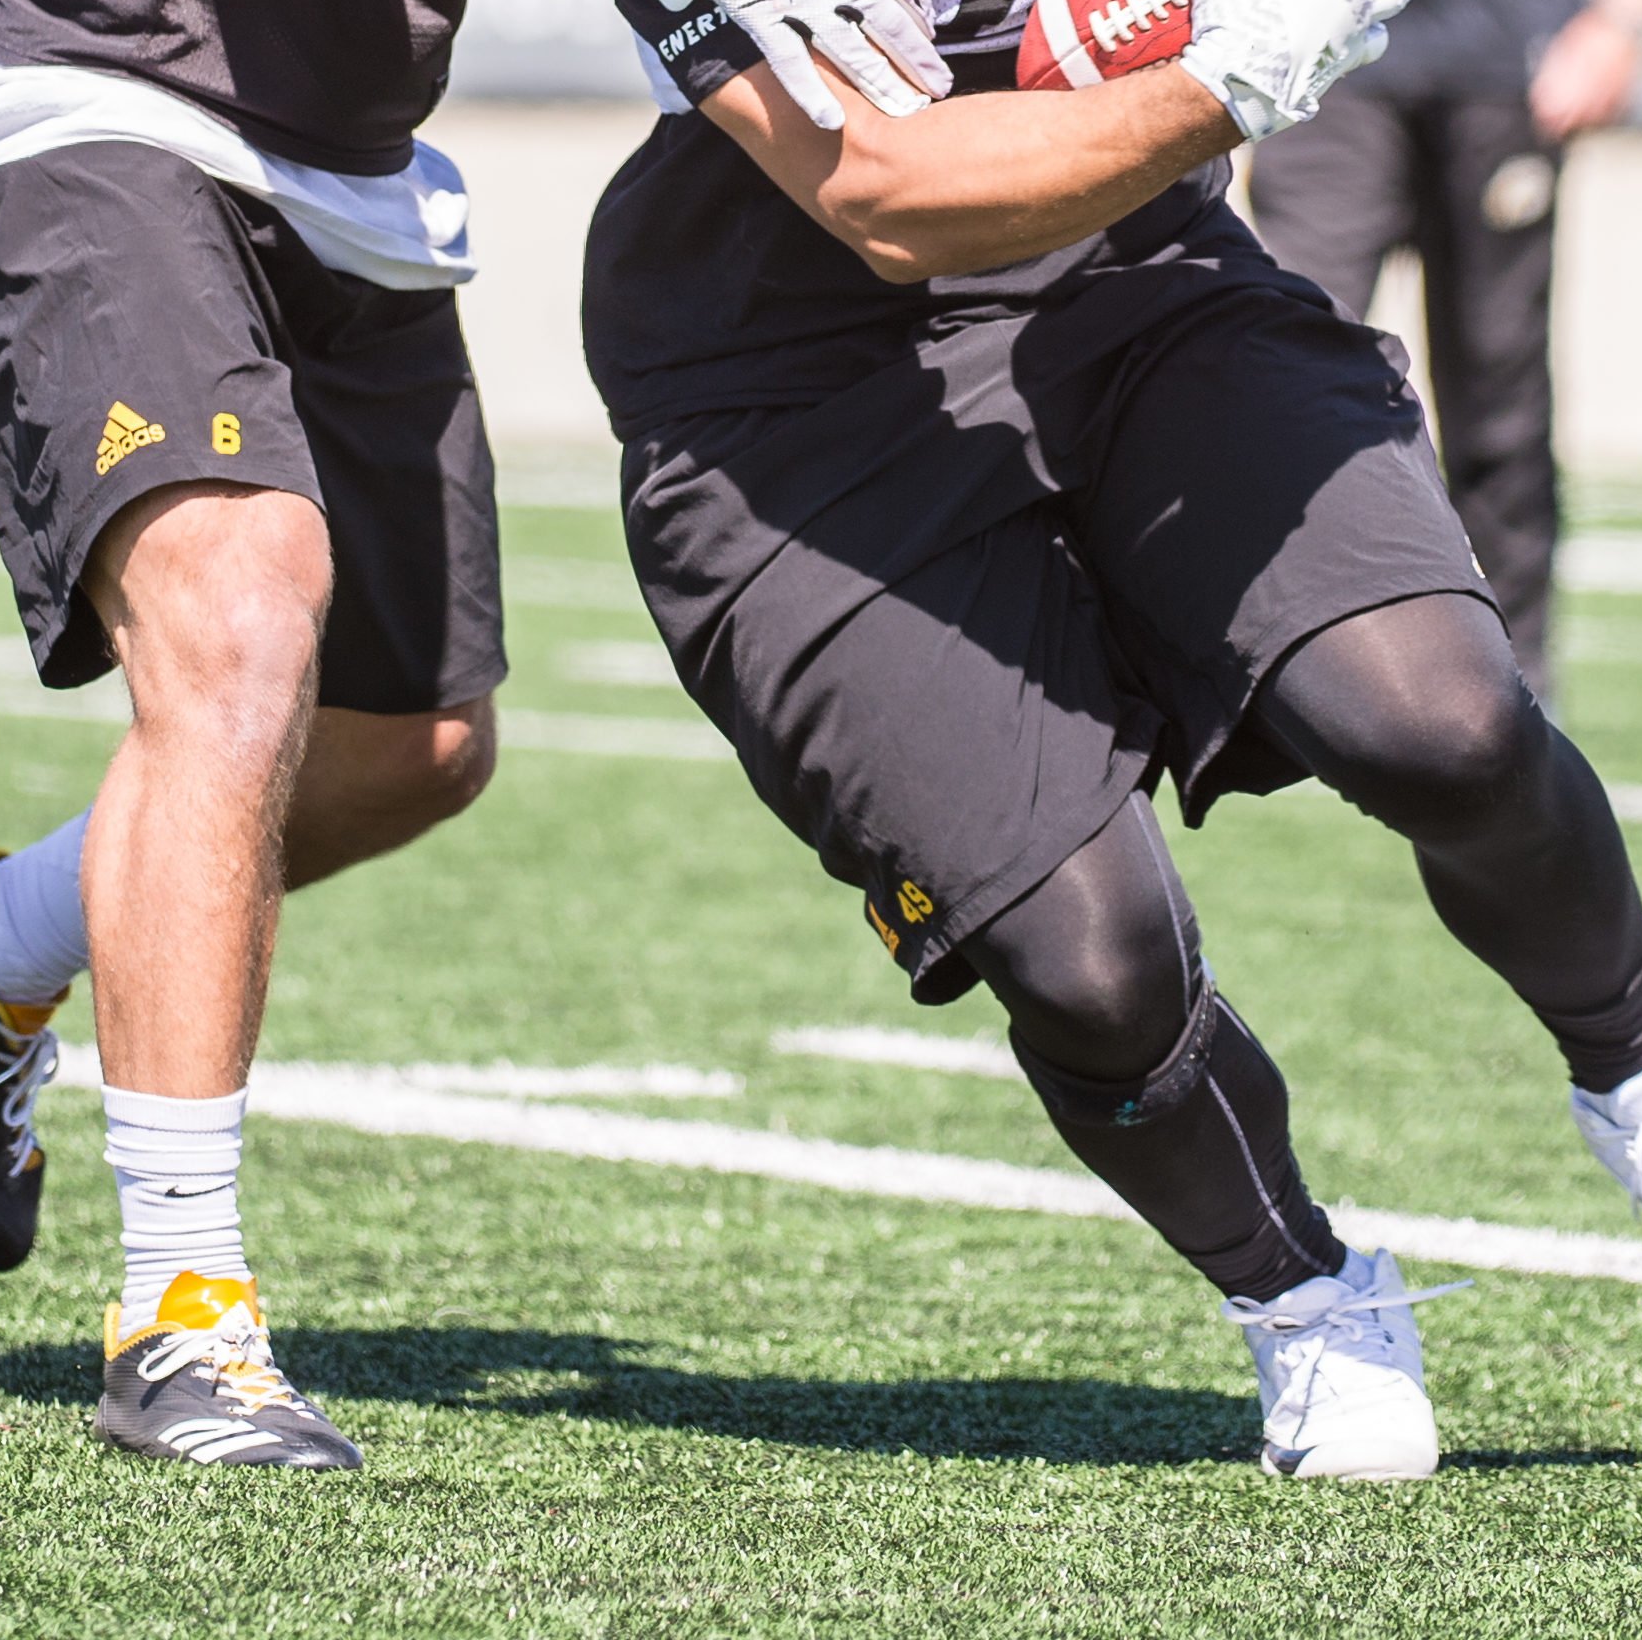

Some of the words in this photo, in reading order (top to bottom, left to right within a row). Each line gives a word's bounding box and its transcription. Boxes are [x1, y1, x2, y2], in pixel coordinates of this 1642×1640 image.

[95, 423, 166, 476] adidas
[211, 412, 241, 456] 6
[896, 880, 933, 924] 49
